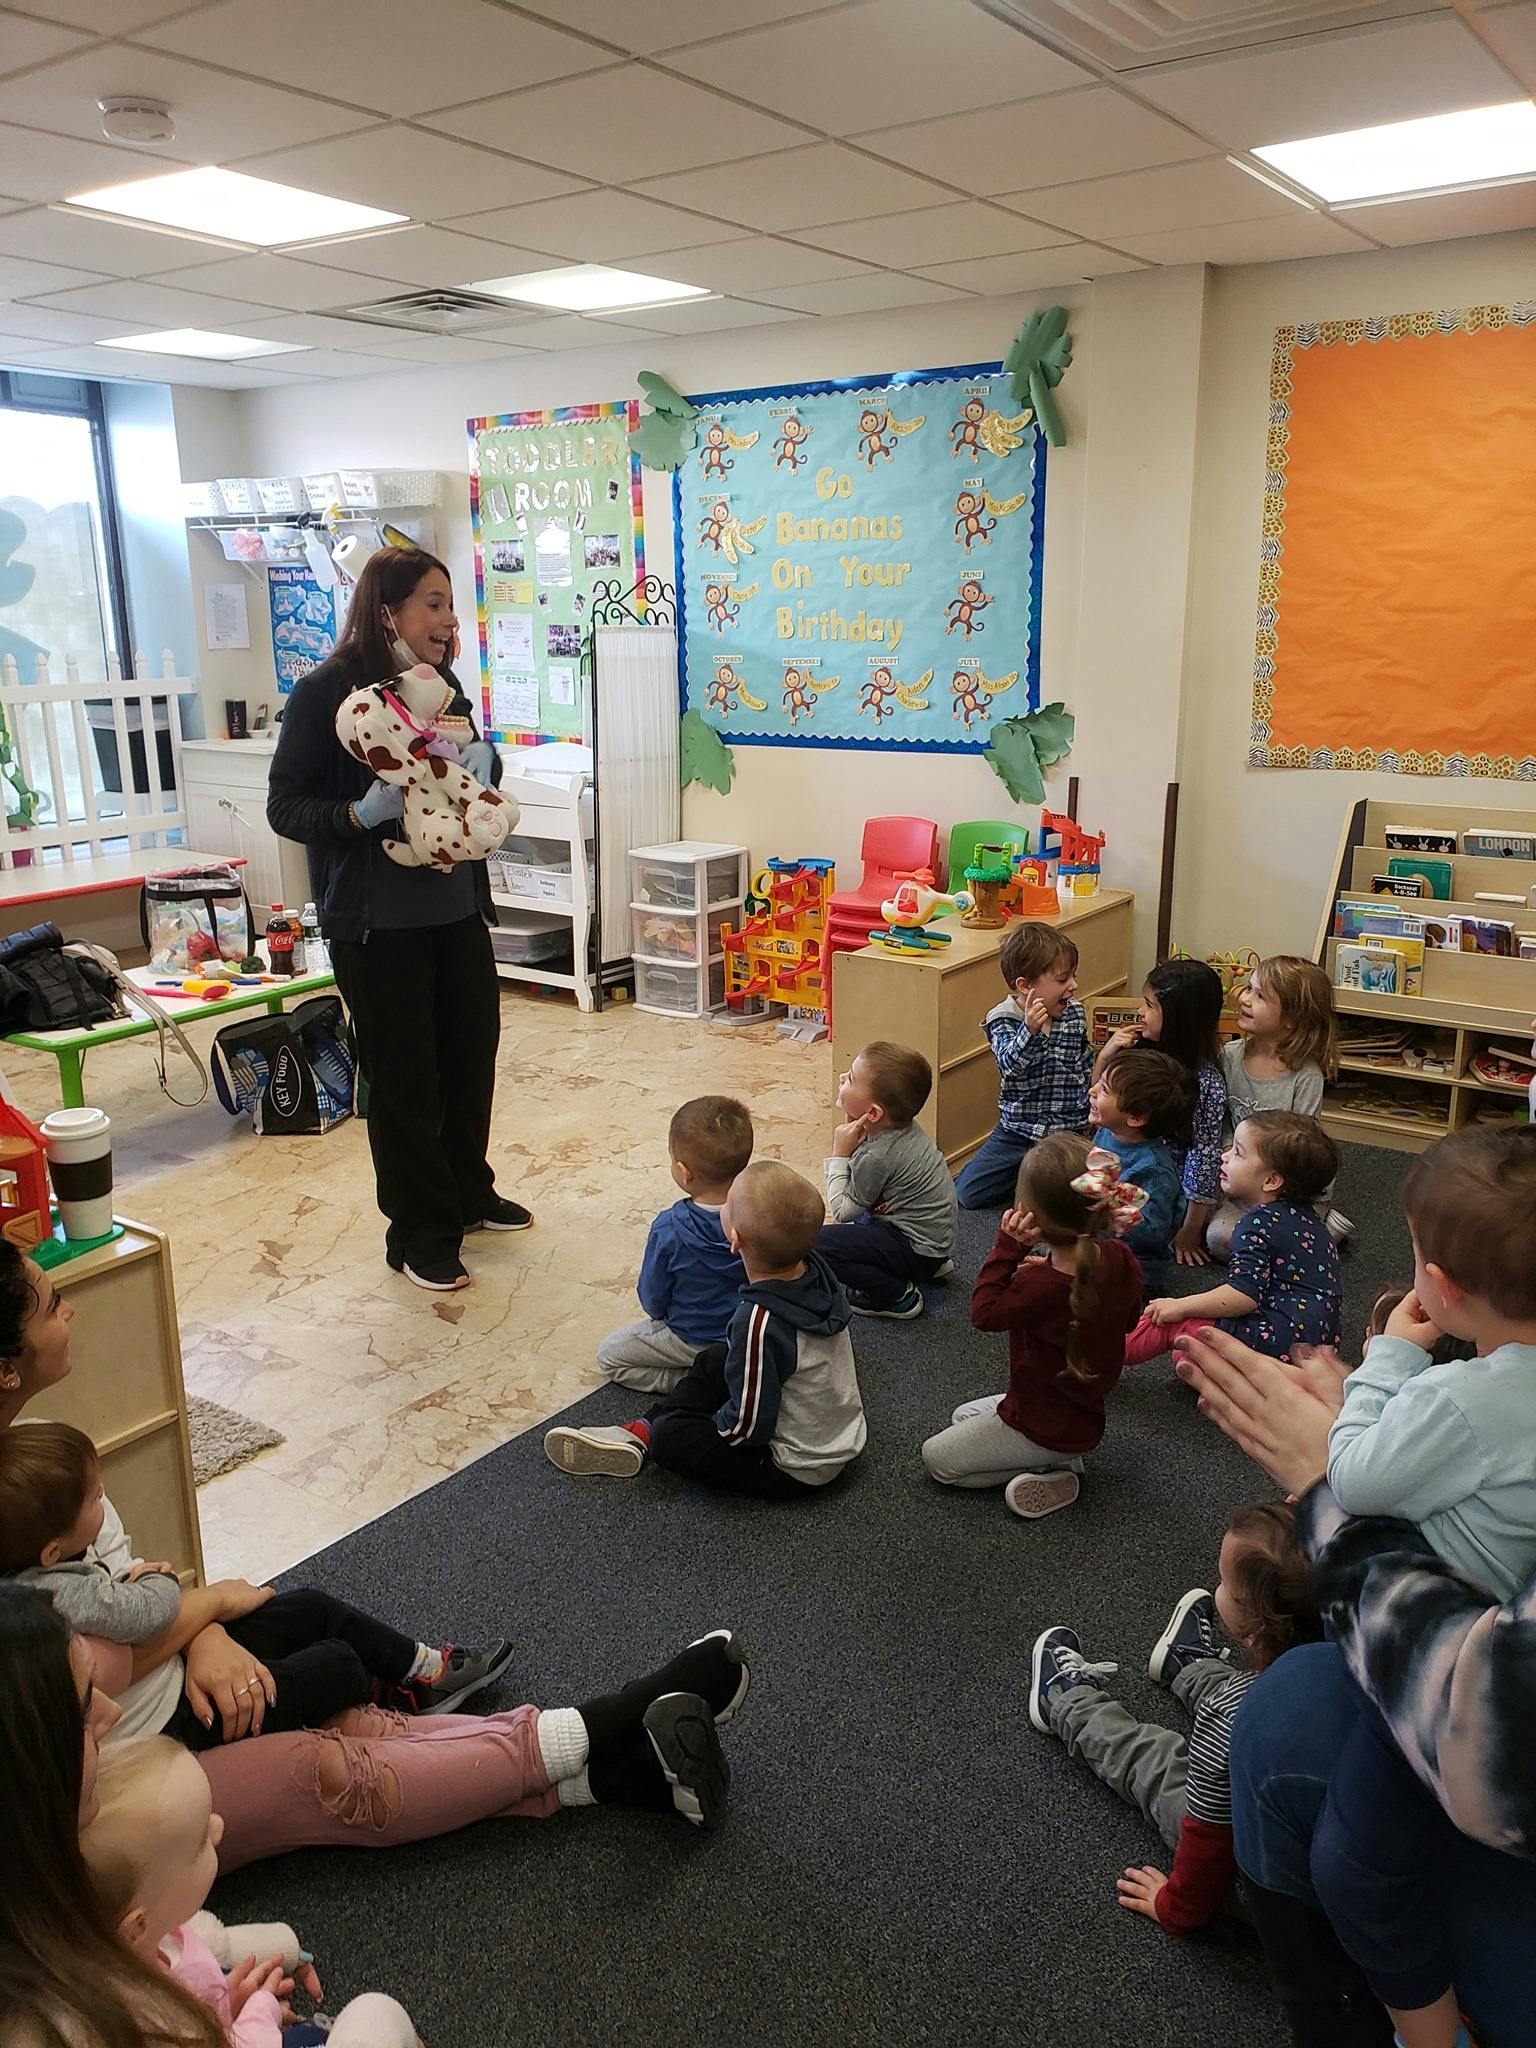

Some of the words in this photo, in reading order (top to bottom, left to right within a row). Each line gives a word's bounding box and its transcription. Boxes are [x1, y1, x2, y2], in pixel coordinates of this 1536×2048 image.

[485, 436, 618, 475] TODDLER
[514, 478, 593, 512] ROOM
[816, 467, 854, 499] Go
[964, 479, 981, 487] MAY
[776, 512, 904, 545] Bananas
[270, 569, 292, 584] Washing
[292, 569, 304, 581] Your
[771, 558, 812, 590] On
[839, 555, 912, 588] Your
[776, 599, 904, 651] Birthday
[1478, 837, 1530, 852] LONDON
[275, 1055, 288, 1083] FOOD
[276, 1087, 292, 1108] KEY
